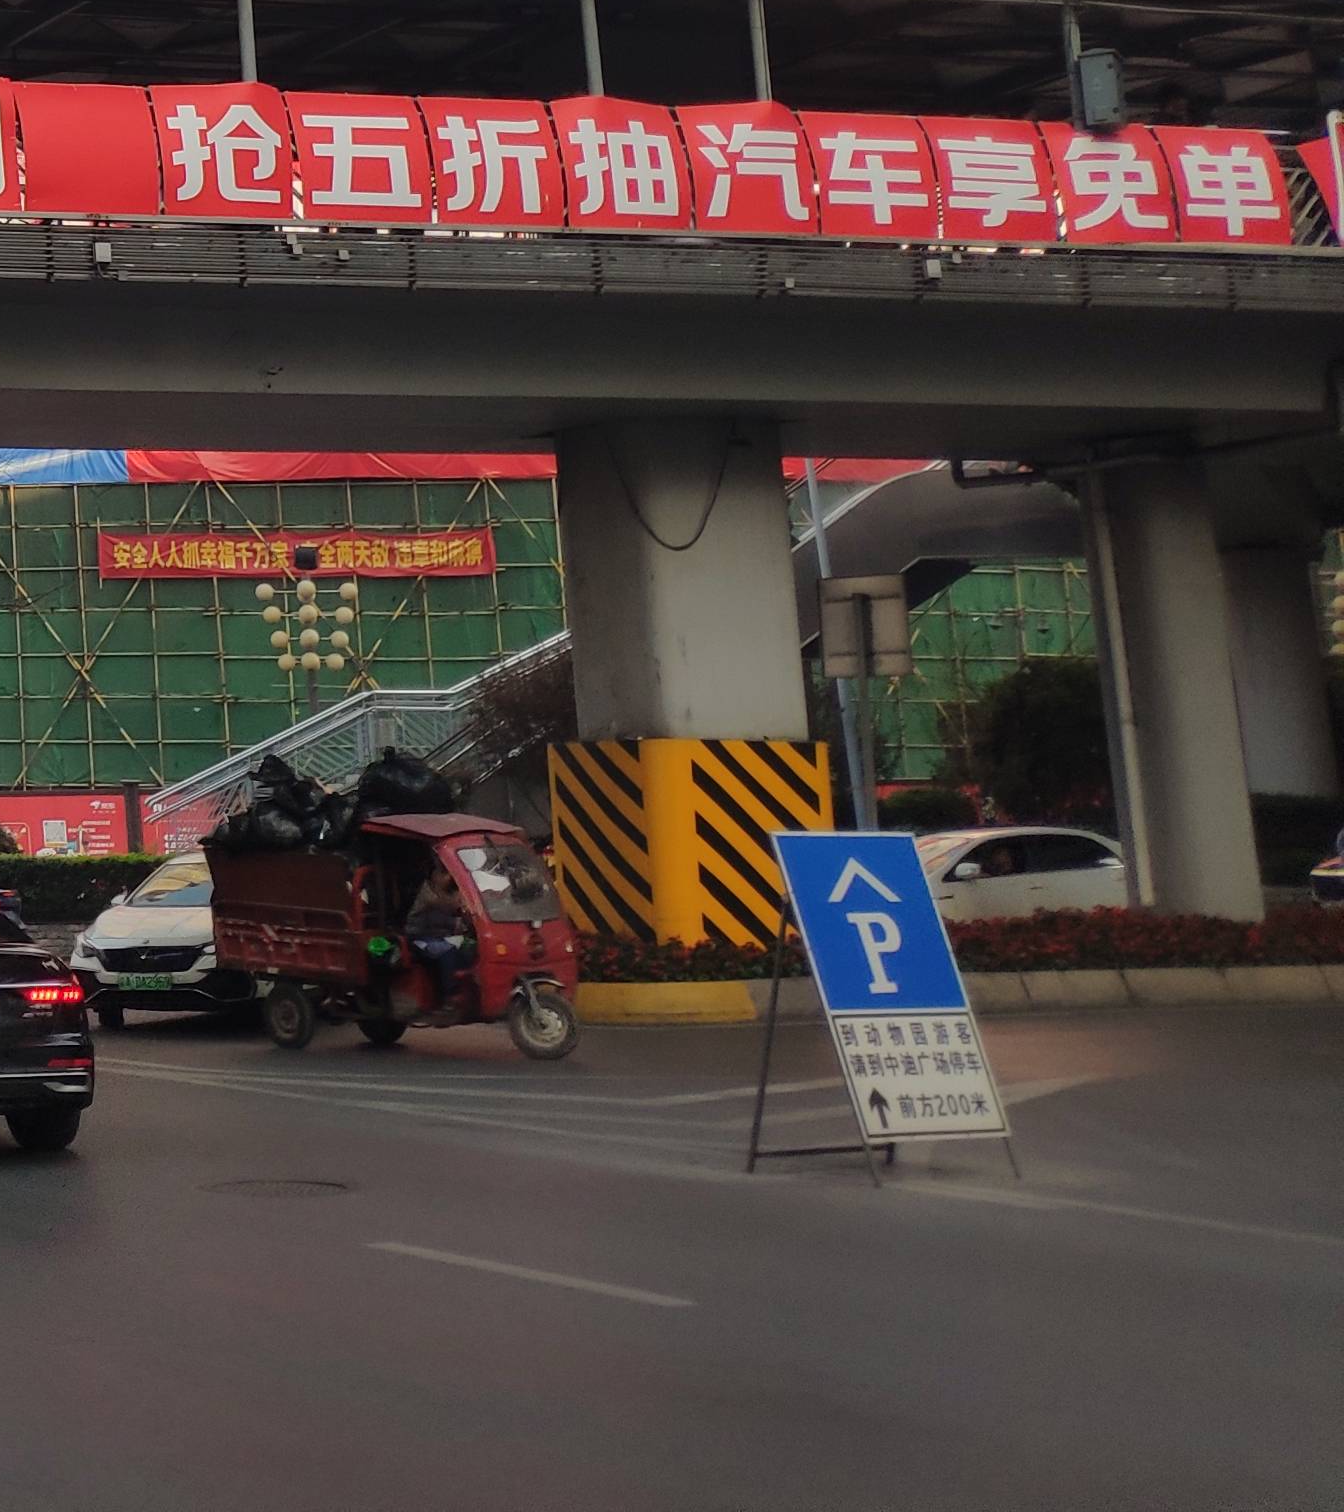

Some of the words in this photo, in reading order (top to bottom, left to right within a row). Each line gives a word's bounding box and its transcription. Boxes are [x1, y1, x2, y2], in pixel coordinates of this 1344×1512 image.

[166, 102, 1282, 238] 抢五折抽汽车享免单
[847, 912, 902, 994] P
[839, 1021, 972, 1047] 到动物园游客
[896, 1091, 991, 1119] 前方200米
